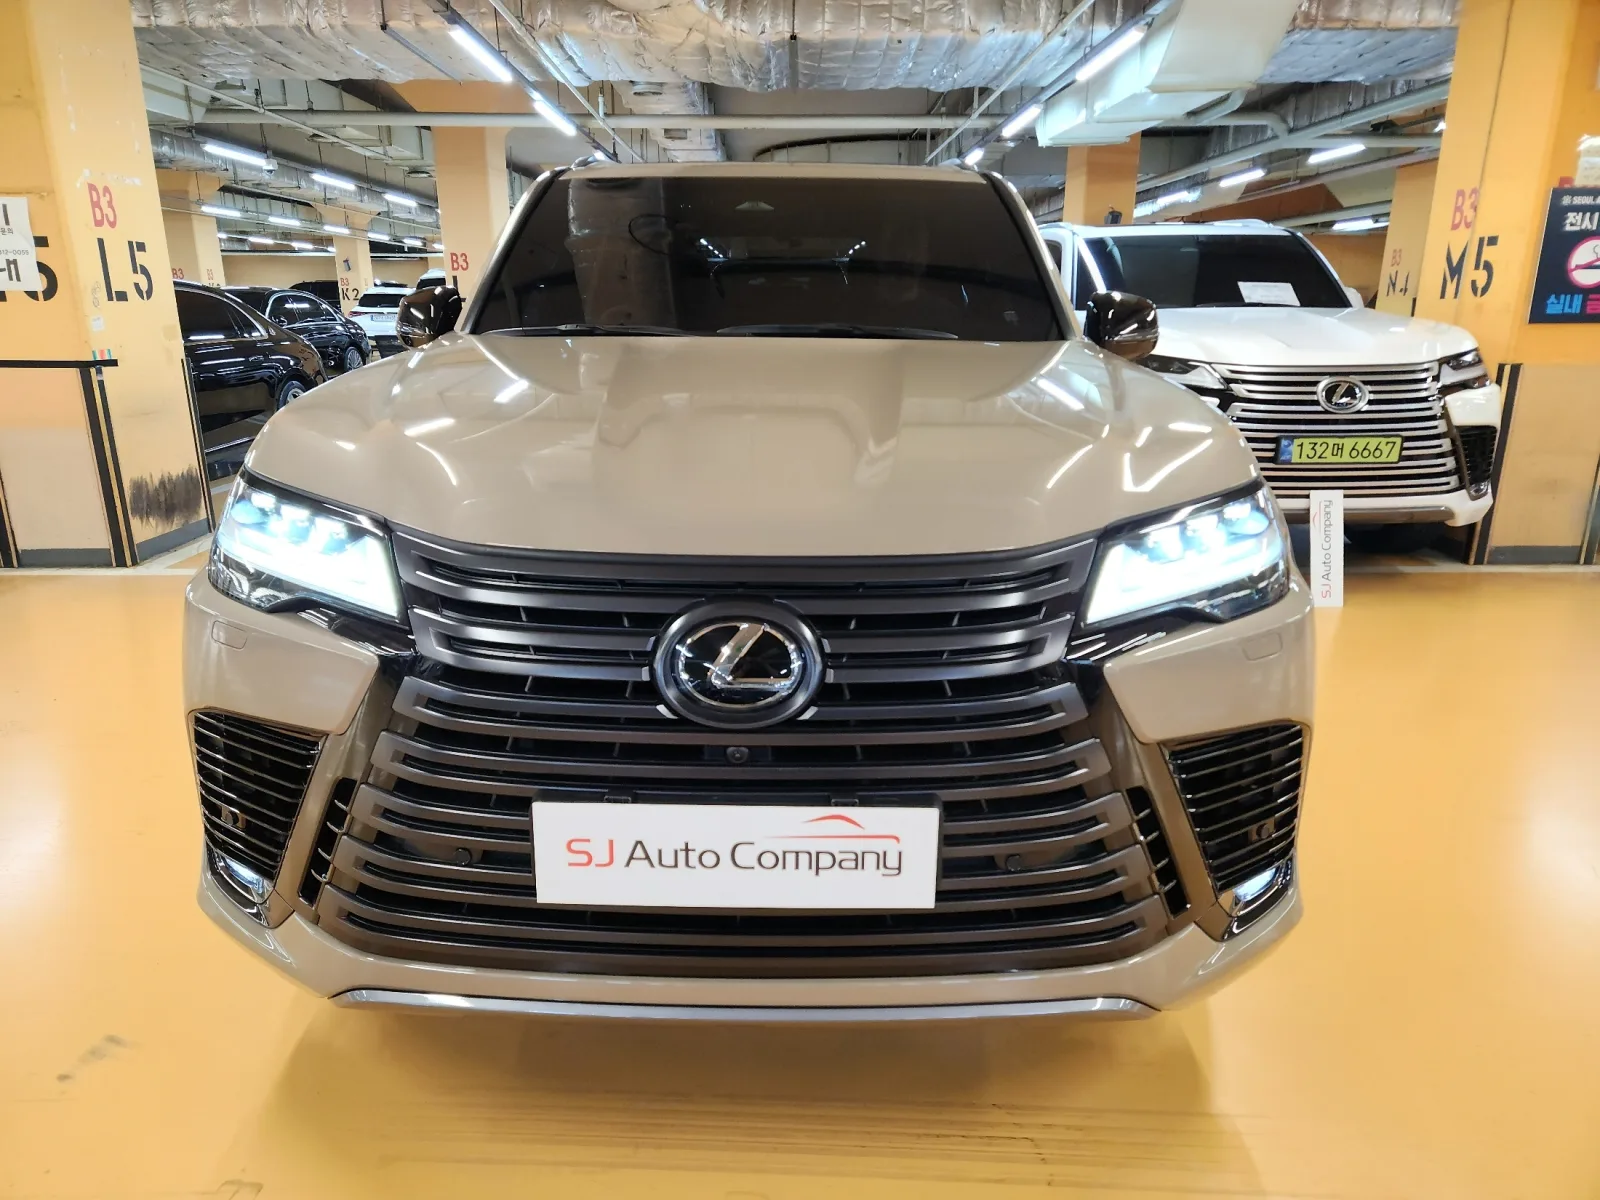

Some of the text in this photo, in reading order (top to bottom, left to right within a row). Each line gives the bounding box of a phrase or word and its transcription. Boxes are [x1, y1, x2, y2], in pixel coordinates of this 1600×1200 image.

[87, 182, 117, 229] B3
[1451, 189, 1478, 231] B3
[97, 238, 153, 302] L5
[340, 278, 350, 287] B3
[450, 252, 469, 271] B3
[1440, 235, 1499, 299] M5
[1546, 294, 1583, 314] 실내
[1321, 499, 1334, 599] SJ Auto Company
[565, 838, 902, 877] SJ Auto Company
